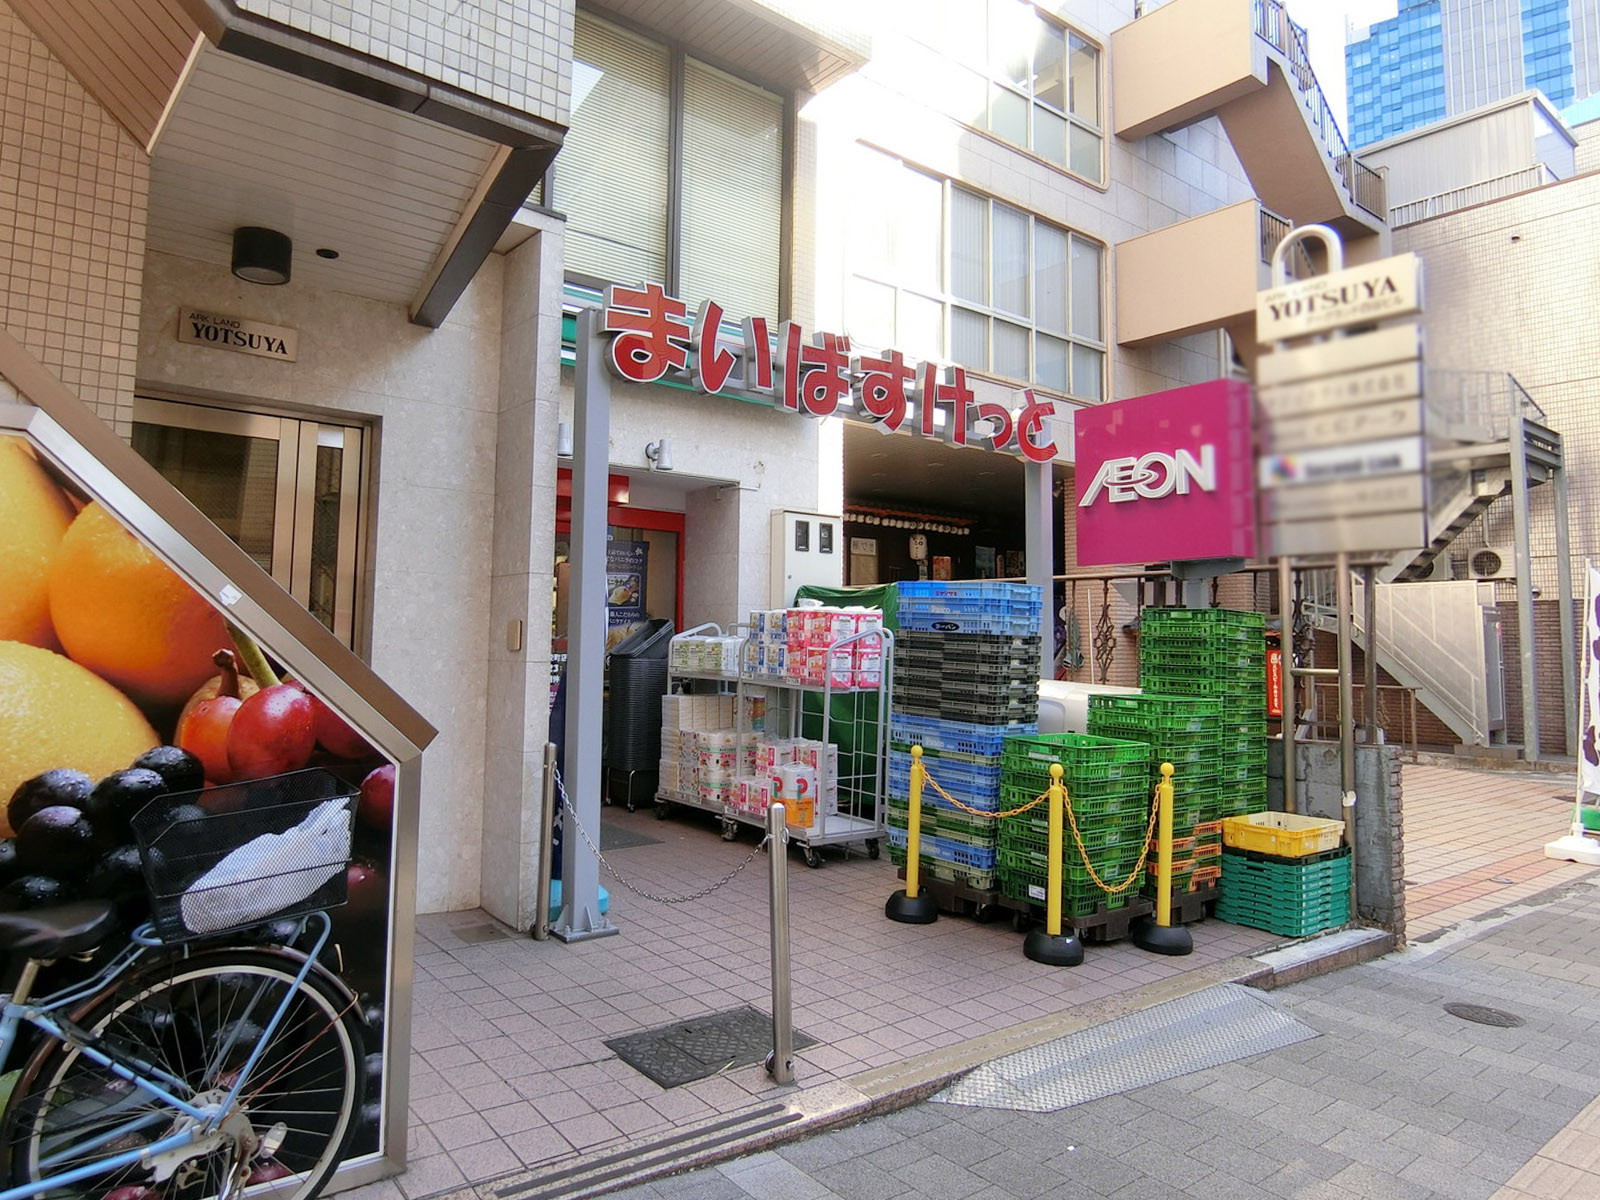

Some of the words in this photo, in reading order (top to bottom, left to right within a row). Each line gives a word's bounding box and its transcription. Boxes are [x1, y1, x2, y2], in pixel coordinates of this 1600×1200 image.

[1270, 276, 1398, 322] YOTSUYA
[189, 312, 209, 323] ARK
[213, 317, 241, 330] LAND
[192, 322, 289, 356] YOTSUYA
[604, 281, 1060, 464] まいばすけっと
